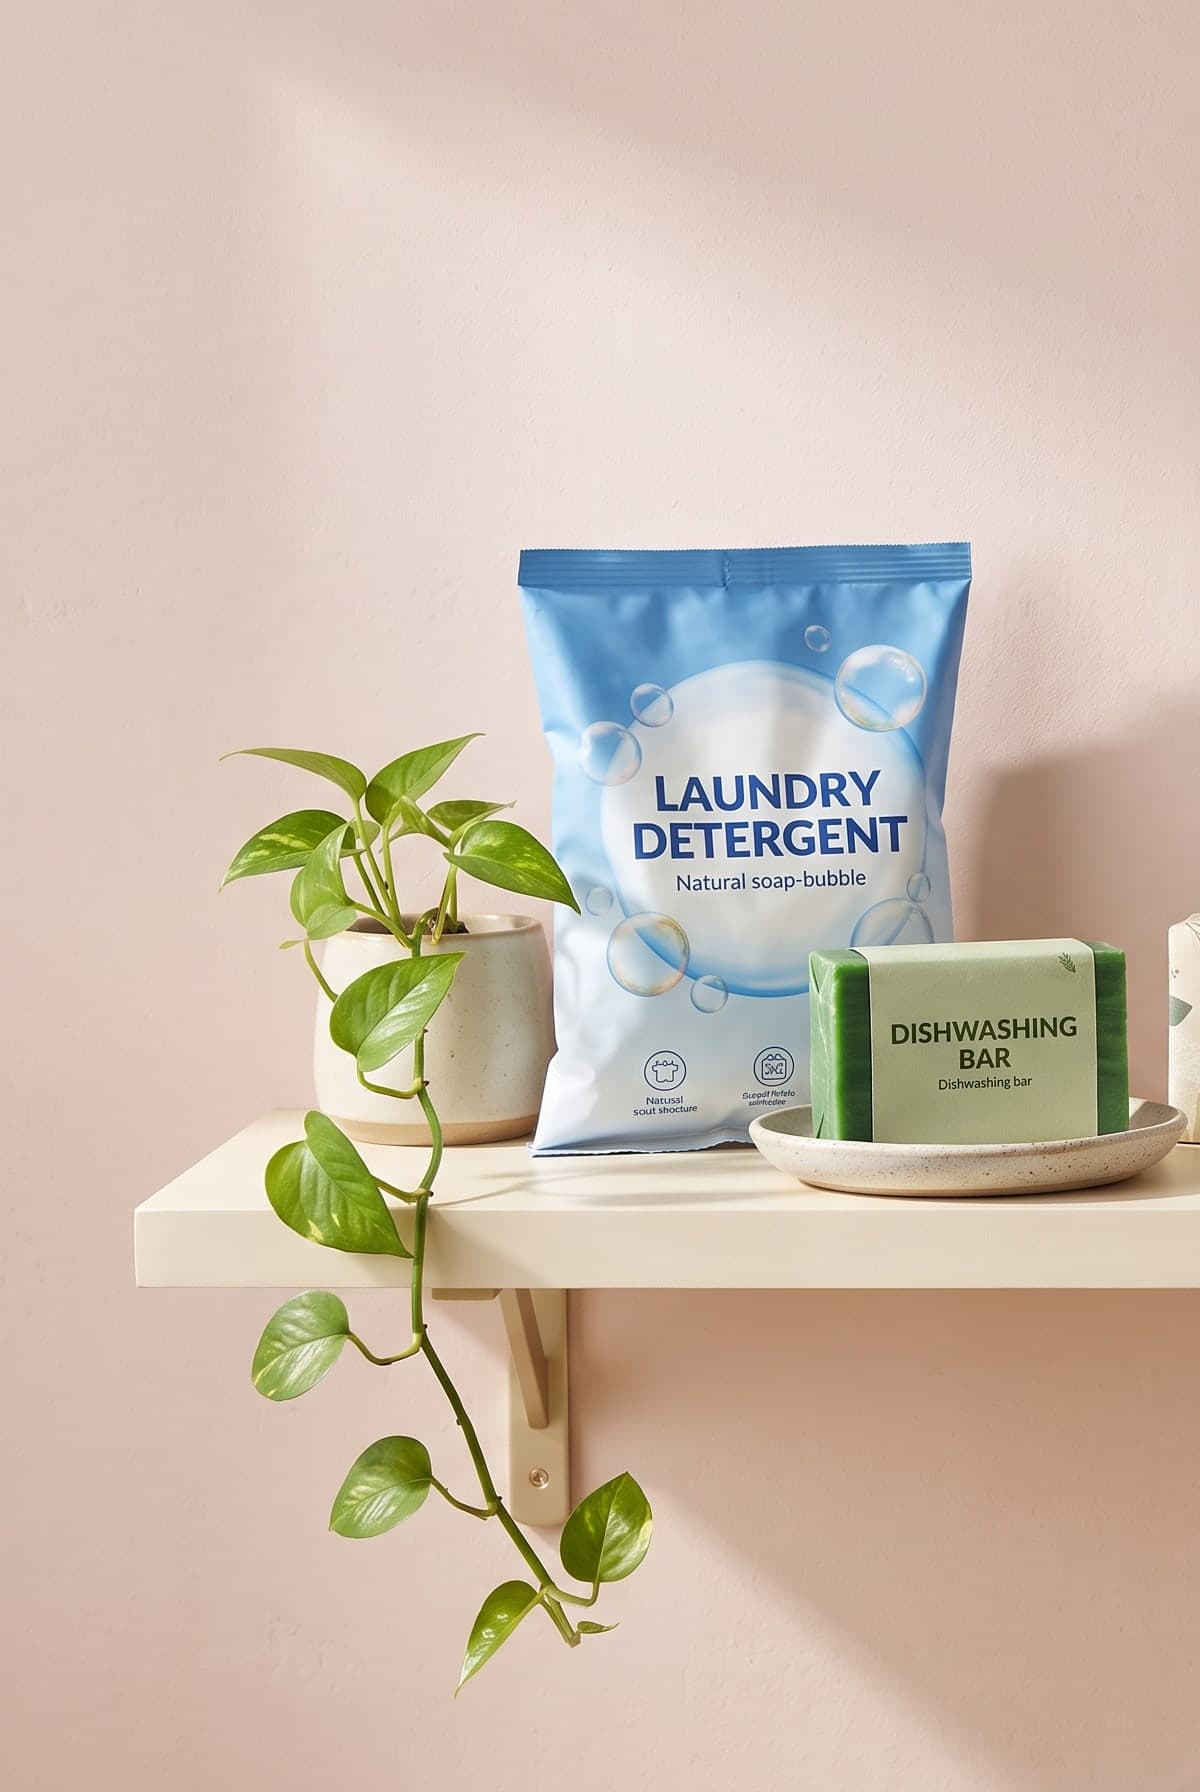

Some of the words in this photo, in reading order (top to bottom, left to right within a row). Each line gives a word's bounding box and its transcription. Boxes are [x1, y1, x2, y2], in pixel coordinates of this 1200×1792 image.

[655, 769, 881, 812] LAUNDRY
[633, 815, 908, 860] DETERGENT
[676, 873, 746, 892] Natural
[751, 869, 866, 894] soap-bubble
[891, 1016, 1078, 1045] DISHWASHING
[959, 1047, 1011, 1070] BAR
[938, 1076, 1011, 1091] Dishwashing
[1013, 1076, 1033, 1088] bar
